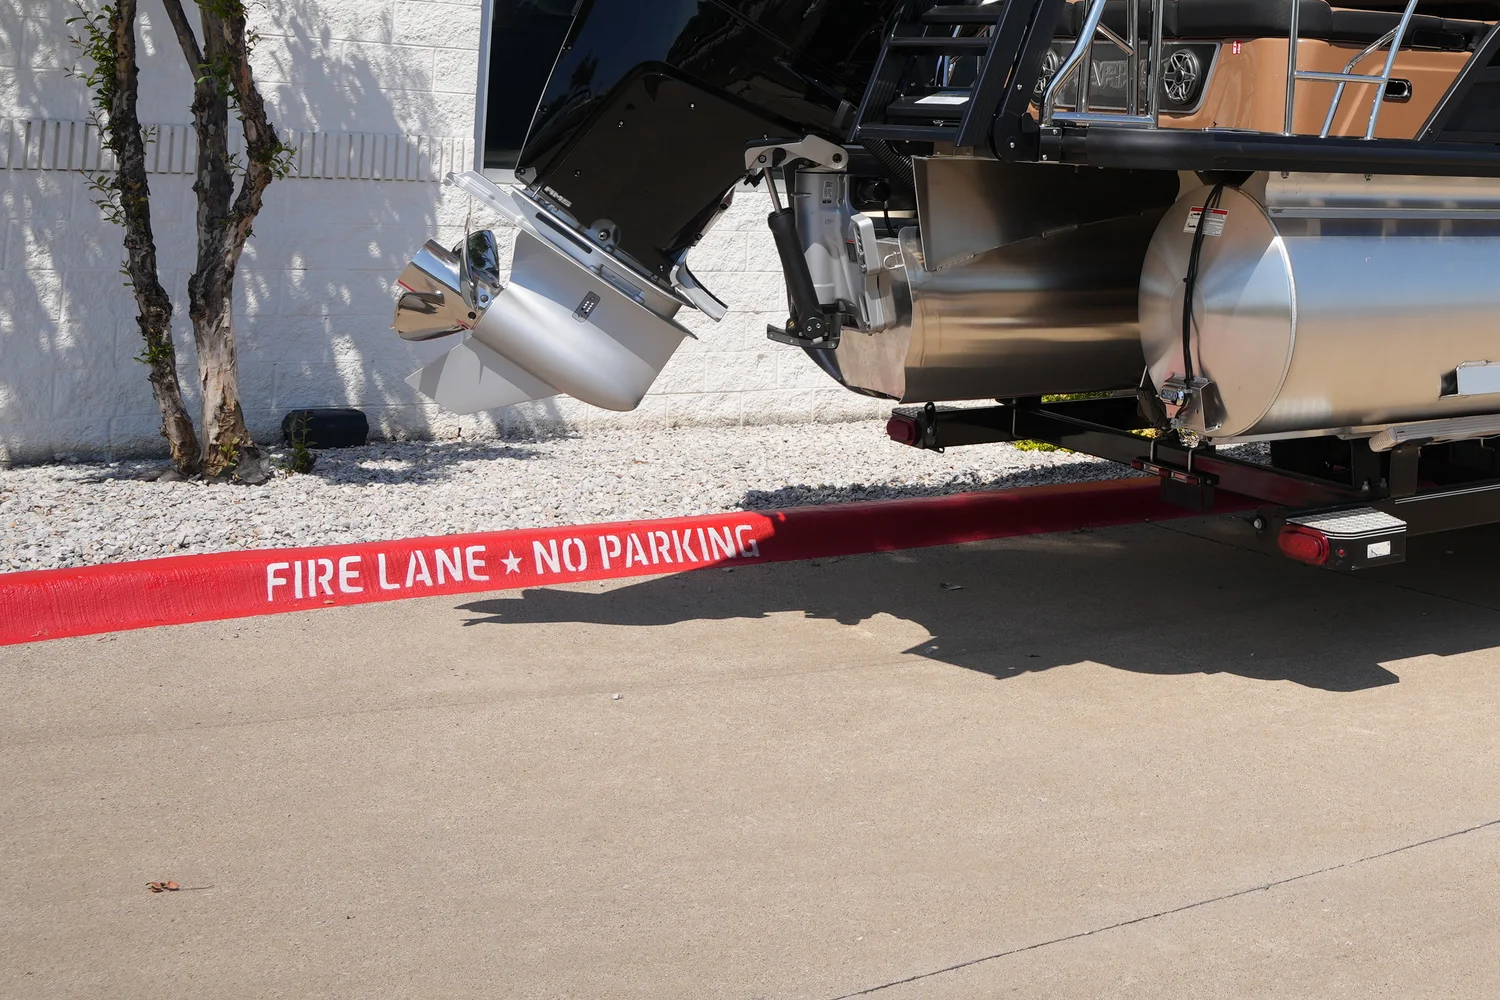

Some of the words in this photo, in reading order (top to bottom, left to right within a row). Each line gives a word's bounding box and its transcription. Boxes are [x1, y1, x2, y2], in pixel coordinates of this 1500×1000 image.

[266, 555, 363, 601] FIRE
[378, 545, 490, 590] LANE
[532, 537, 588, 575] NO
[599, 524, 760, 570] PARKING
